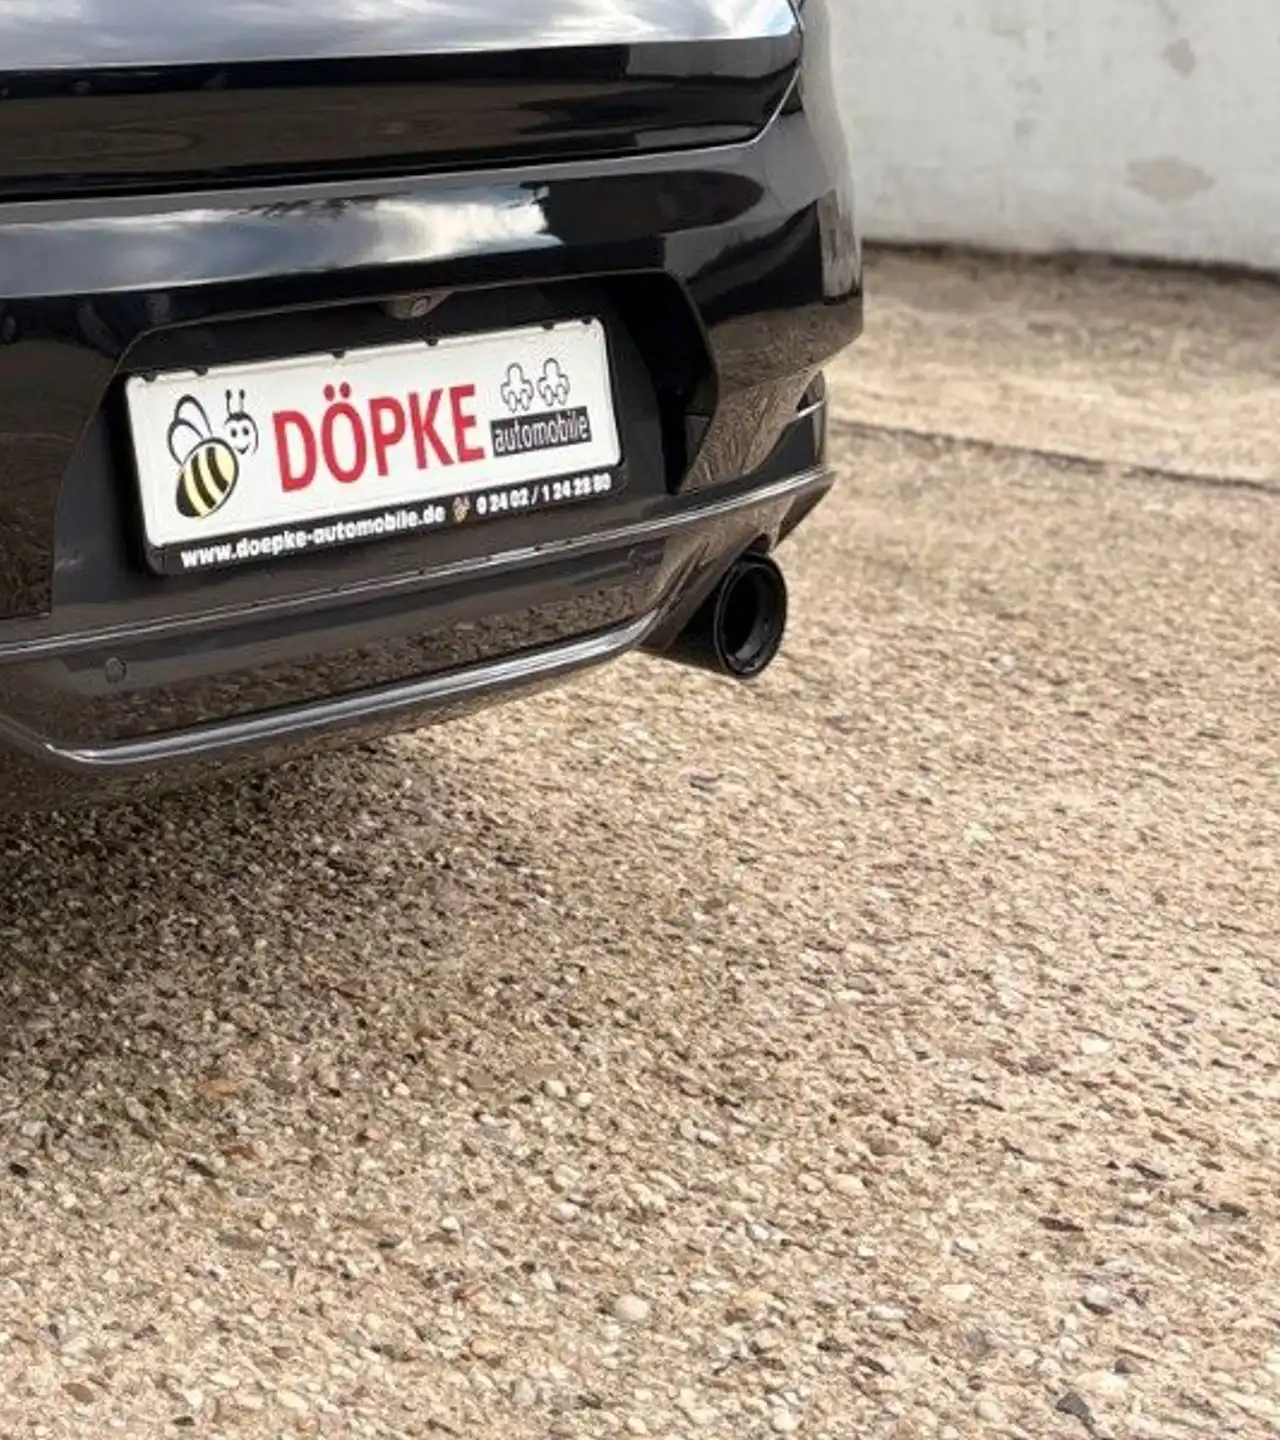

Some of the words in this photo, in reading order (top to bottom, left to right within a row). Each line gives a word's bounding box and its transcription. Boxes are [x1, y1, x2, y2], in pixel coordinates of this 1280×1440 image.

[272, 381, 486, 493] DÖPKE
[494, 410, 589, 453] automobile
[180, 503, 446, 568] www.doepke-automobile.de
